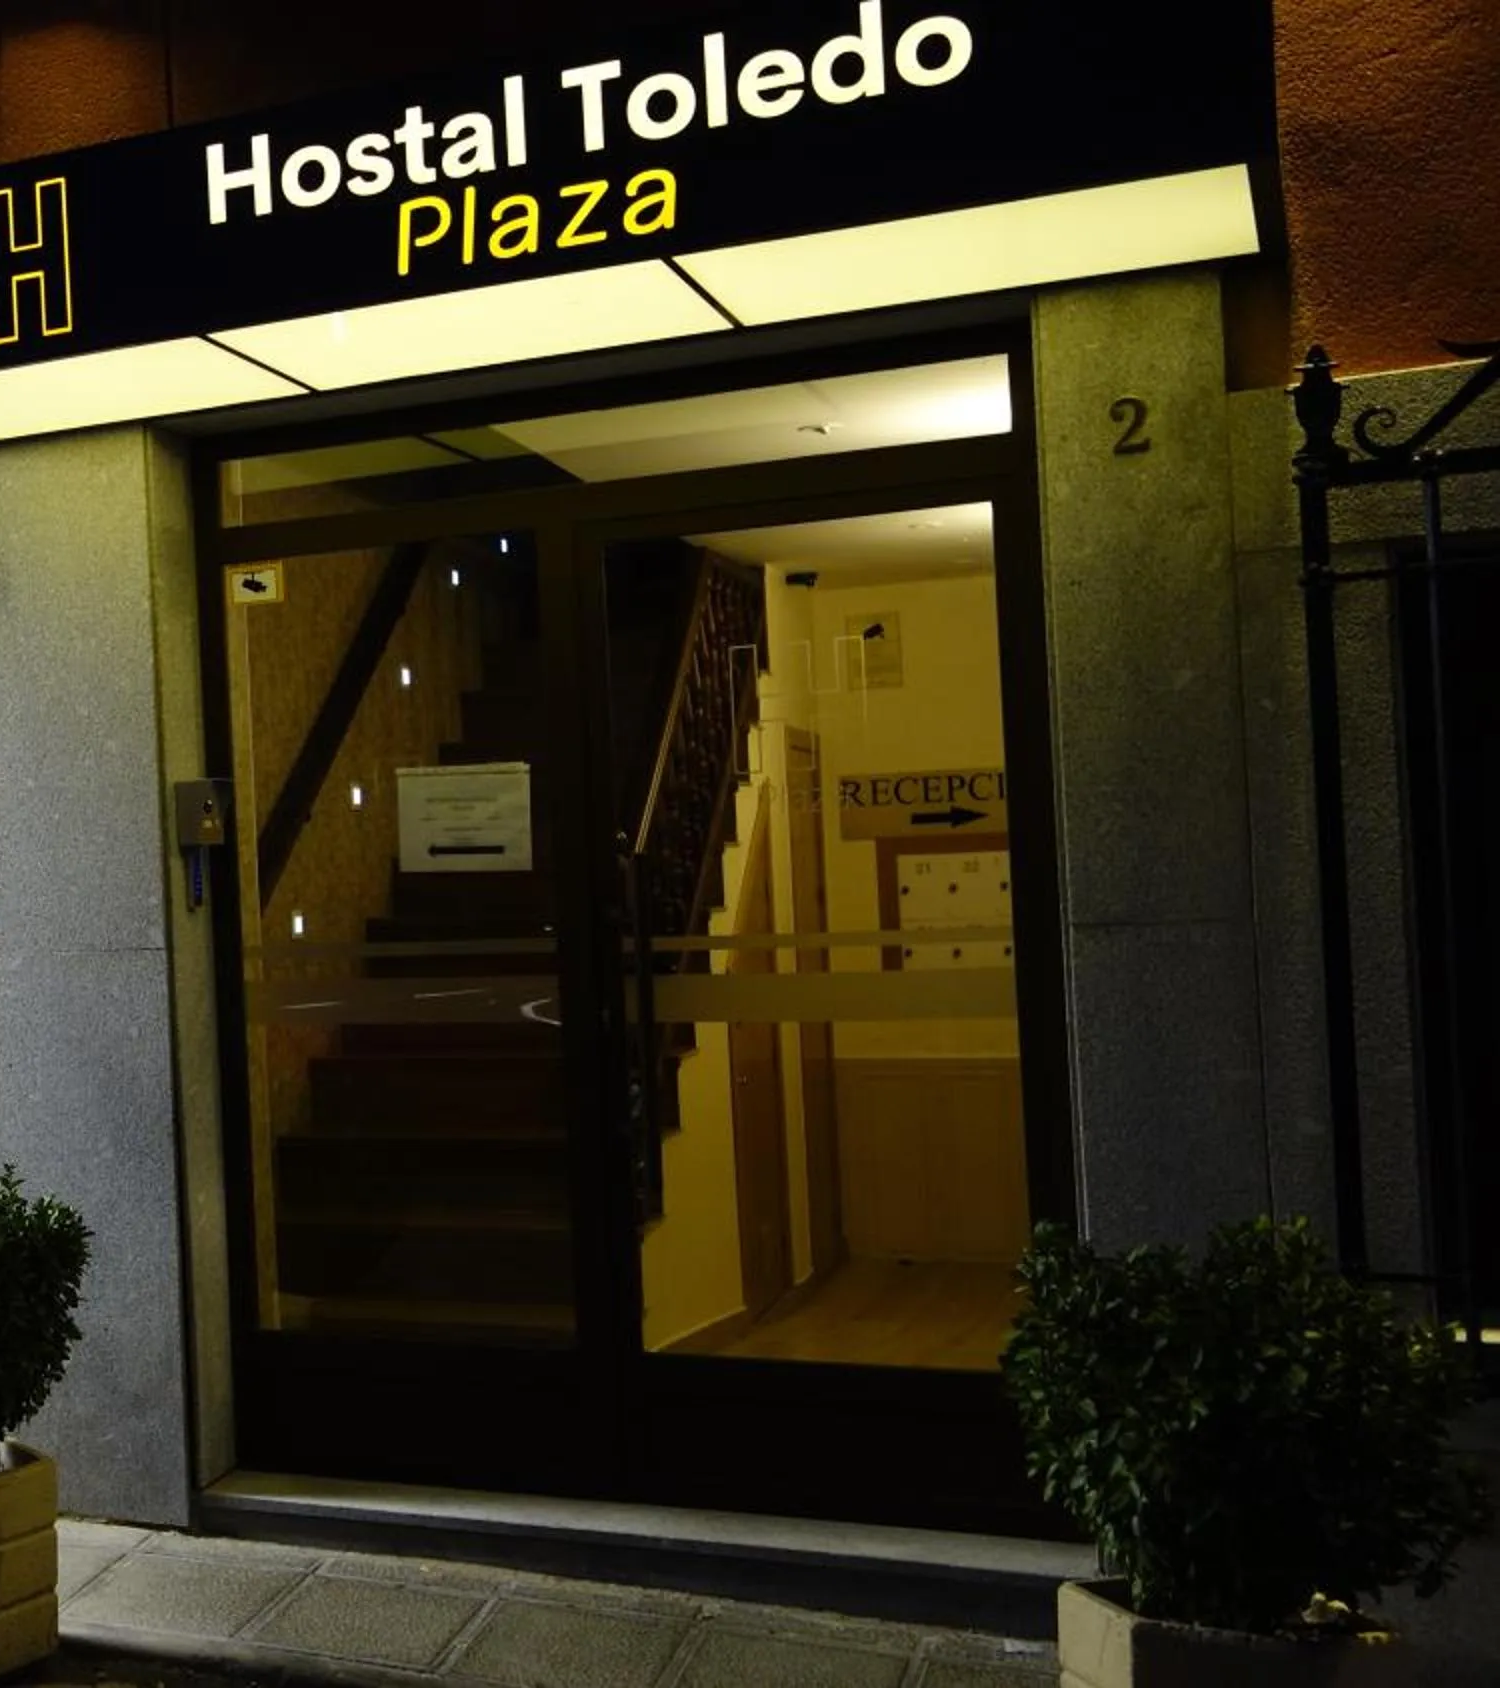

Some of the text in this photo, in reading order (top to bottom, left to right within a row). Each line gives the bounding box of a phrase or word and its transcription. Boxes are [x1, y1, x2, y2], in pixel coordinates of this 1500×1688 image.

[206, 0, 974, 225] Hostal Toledo
[396, 168, 679, 276] Plaza
[1109, 398, 1152, 455] 2
